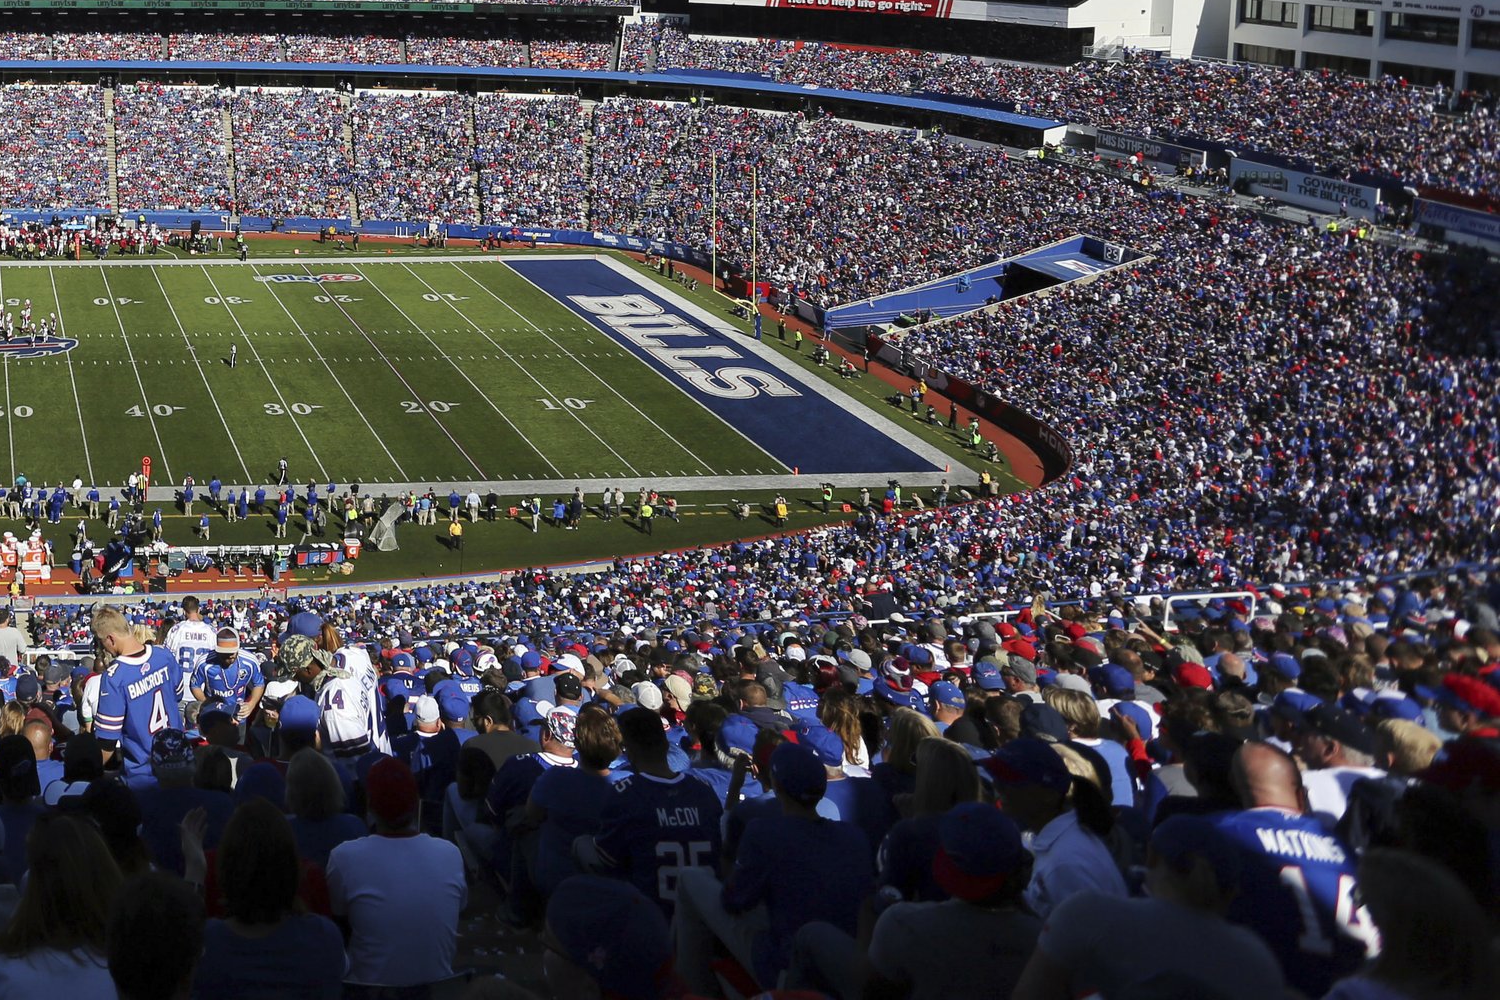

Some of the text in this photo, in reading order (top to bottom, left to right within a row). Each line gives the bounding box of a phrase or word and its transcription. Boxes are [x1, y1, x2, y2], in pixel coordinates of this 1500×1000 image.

[878, 1, 893, 11] go
[1296, 184, 1319, 199] THE
[1303, 176, 1362, 197] GO WHERE
[566, 293, 803, 400] BILLS
[124, 404, 174, 418] 40
[263, 402, 312, 416] 30
[399, 401, 452, 414] 20
[536, 397, 589, 411] 10
[184, 631, 208, 642] EVANS
[127, 667, 170, 700] BANCROFT
[323, 687, 345, 711] 14
[148, 689, 169, 735] 4
[656, 806, 701, 828] McCOY
[1256, 827, 1345, 865] WATKINS
